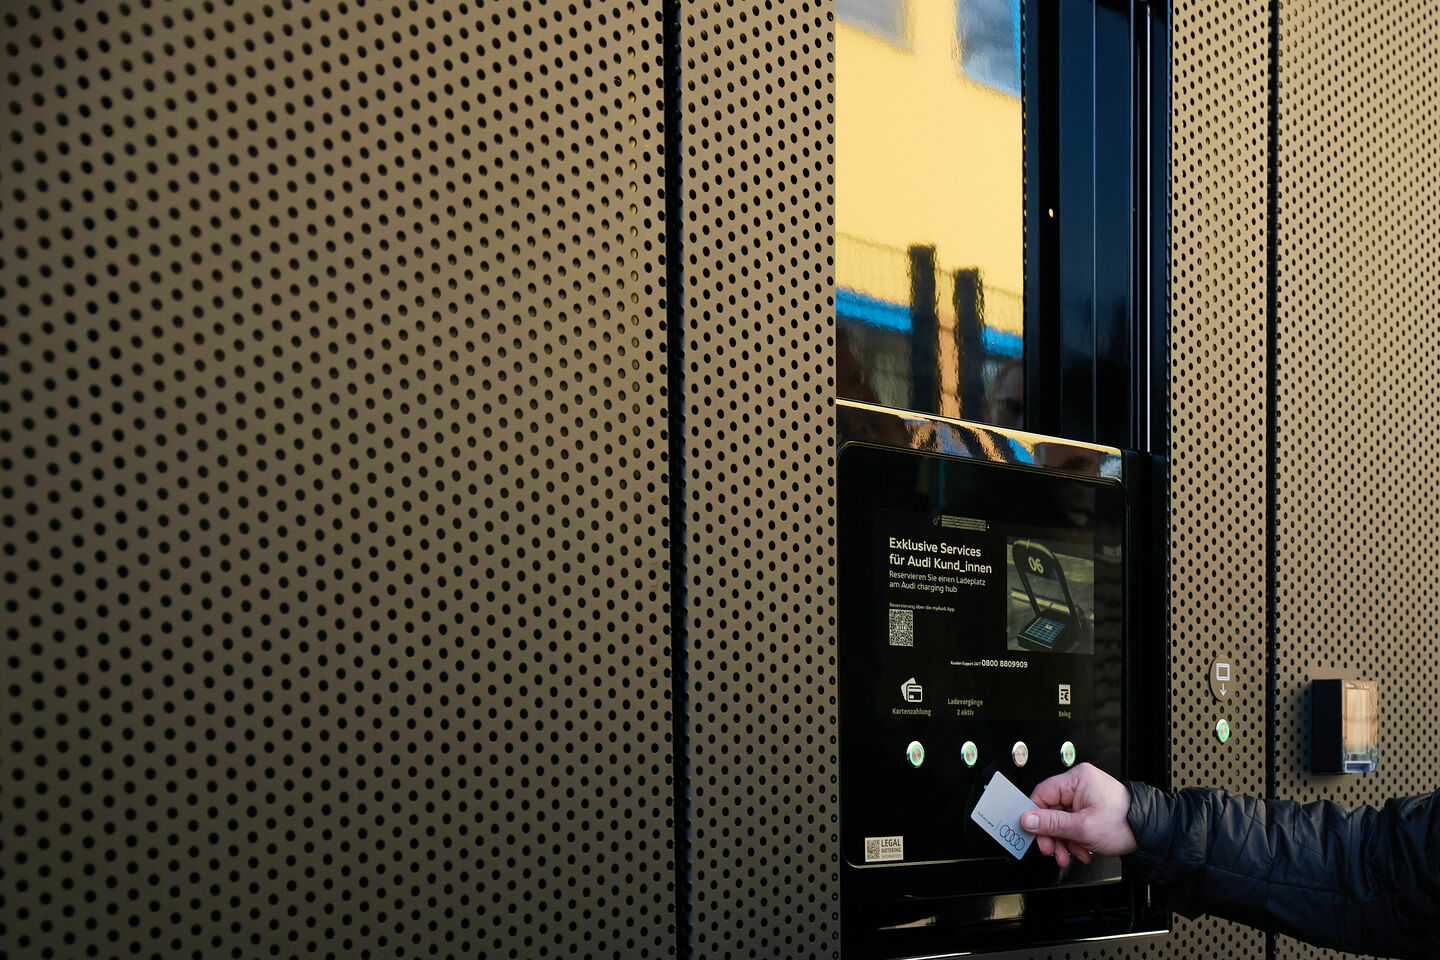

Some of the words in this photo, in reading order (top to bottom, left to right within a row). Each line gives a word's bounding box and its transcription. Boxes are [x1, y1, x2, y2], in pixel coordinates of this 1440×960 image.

[889, 537, 938, 553] Exklusive
[940, 542, 981, 557] Services
[889, 553, 905, 566] für
[907, 555, 931, 568] Audi
[934, 557, 992, 574] Kund_innen
[1027, 555, 1044, 574] 06
[889, 570, 926, 580] Reservieren
[927, 573, 937, 582] Sie
[938, 575, 955, 583] einen
[955, 576, 986, 587] Ladeplatz
[901, 581, 916, 590] Audi
[916, 583, 944, 594] charging
[945, 585, 958, 593] hub
[981, 659, 998, 667] 0800
[999, 660, 1028, 668] 8809909
[947, 698, 984, 707] Ladevorgänge
[892, 707, 931, 717] Kartenzahlung
[881, 838, 901, 847] LEGAL
